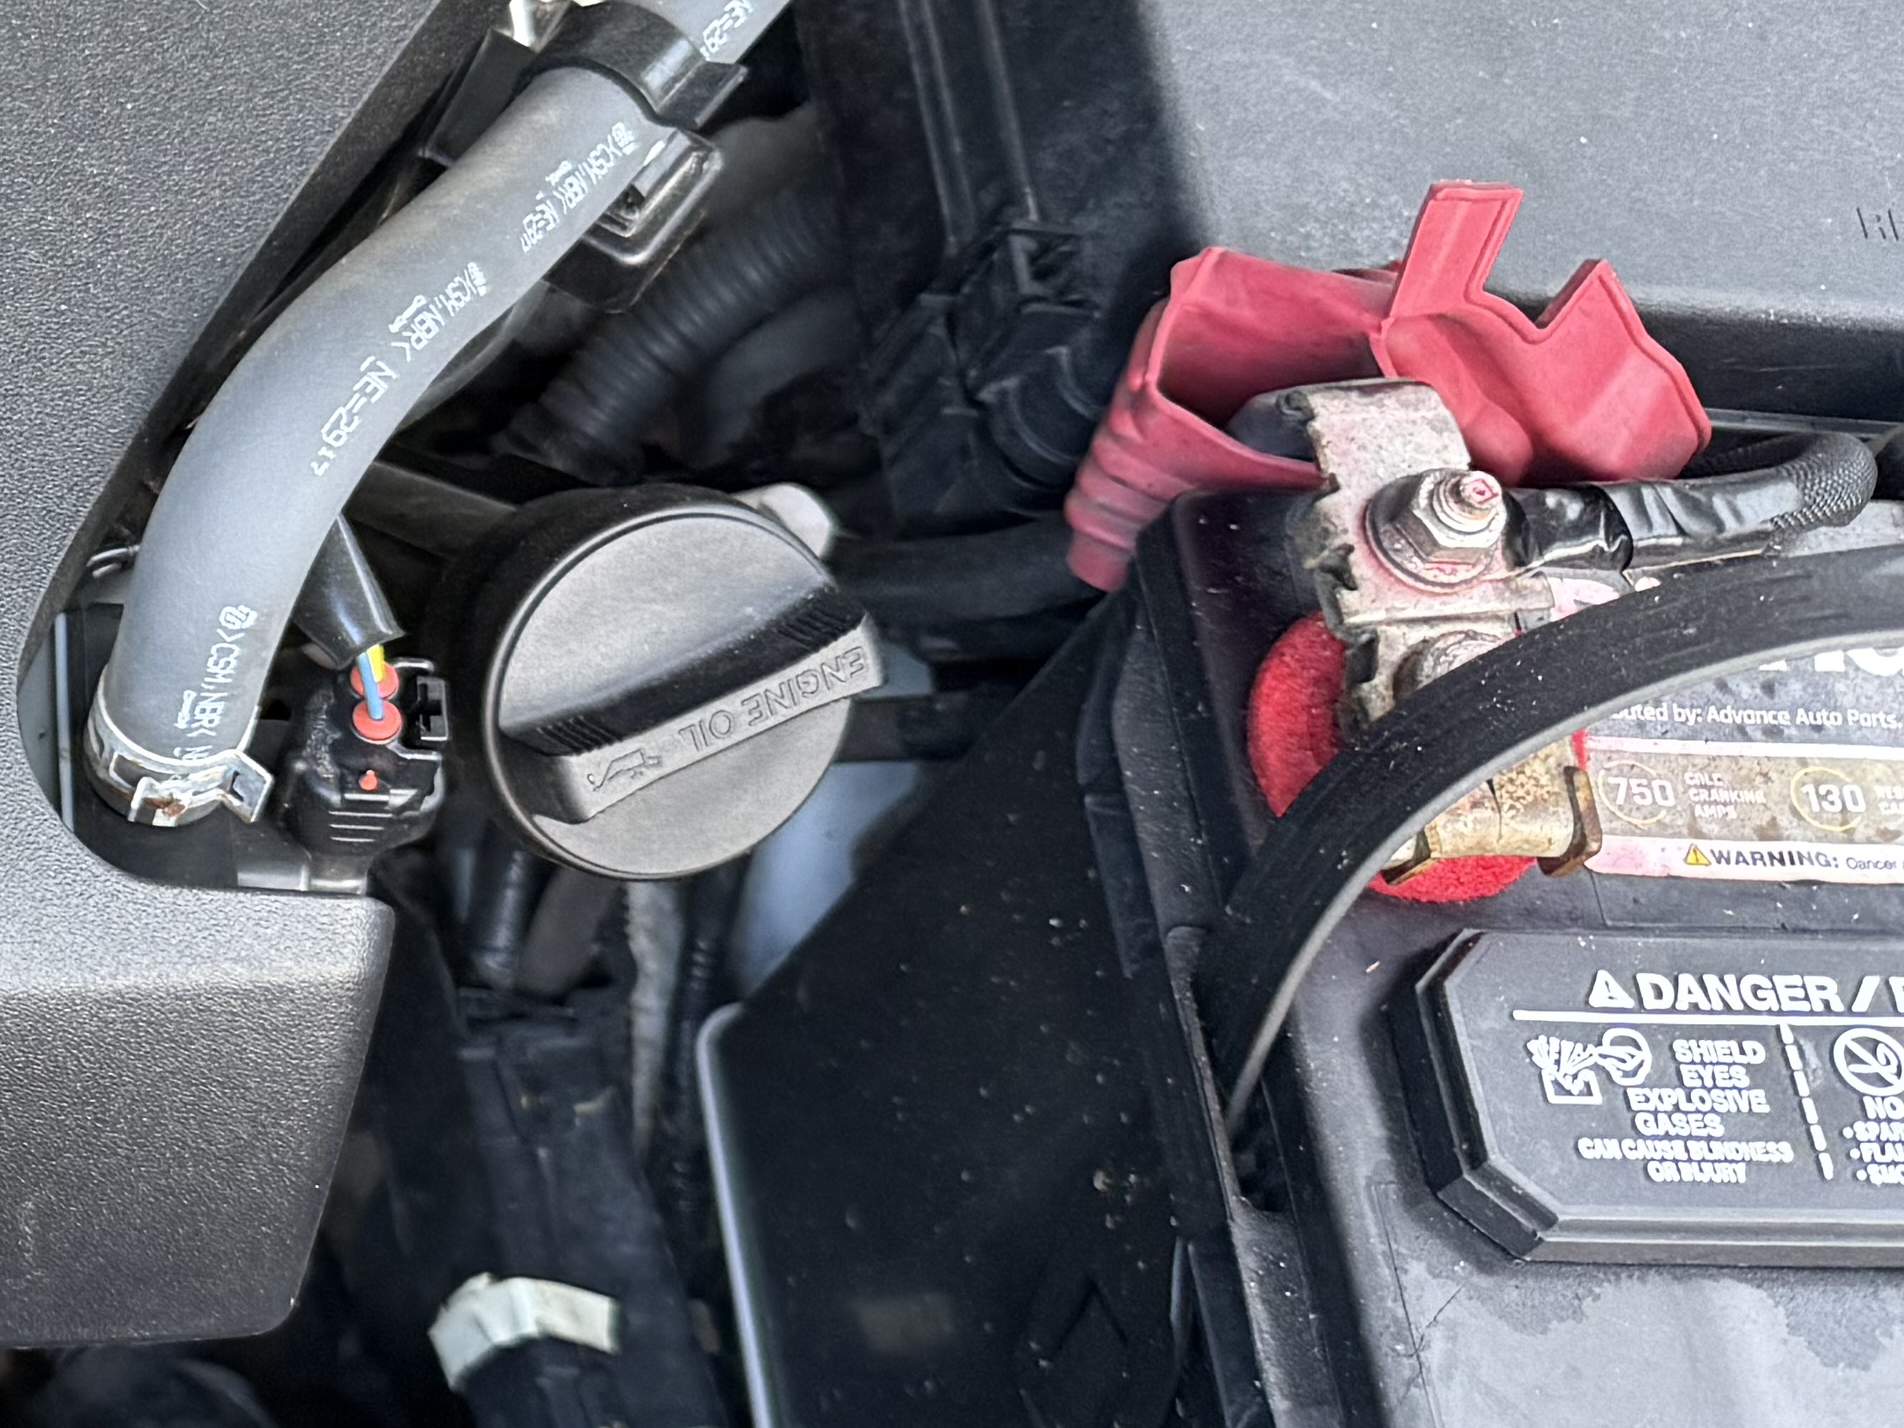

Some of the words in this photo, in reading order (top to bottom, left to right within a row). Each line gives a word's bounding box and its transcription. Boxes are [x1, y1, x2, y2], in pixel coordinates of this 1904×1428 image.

[740, 646, 866, 727] ENGINE
[1672, 702, 1703, 726] by:
[1707, 705, 1791, 726] Advance
[1795, 708, 1842, 727] Auto
[678, 709, 733, 753] OIL
[1607, 776, 1676, 808] 750
[1800, 783, 1867, 813] 130
[1694, 805, 1738, 819] AMPS
[1710, 849, 1839, 869] WARNING:
[1846, 856, 1897, 870] Cancer
[1636, 973, 1844, 1012] DANGER
[1672, 1039, 1766, 1064] SHIELD
[1679, 1064, 1750, 1088] EYES
[1626, 1087, 1771, 1113] EXPLOSIVE
[1634, 1112, 1725, 1137] GASES
[1577, 1137, 1622, 1160] CAN
[1621, 1139, 1688, 1161] CAUSE
[1686, 1139, 1795, 1163] BLINDNESS
[1647, 1160, 1681, 1183] OR
[1678, 1161, 1747, 1183] INJURY
